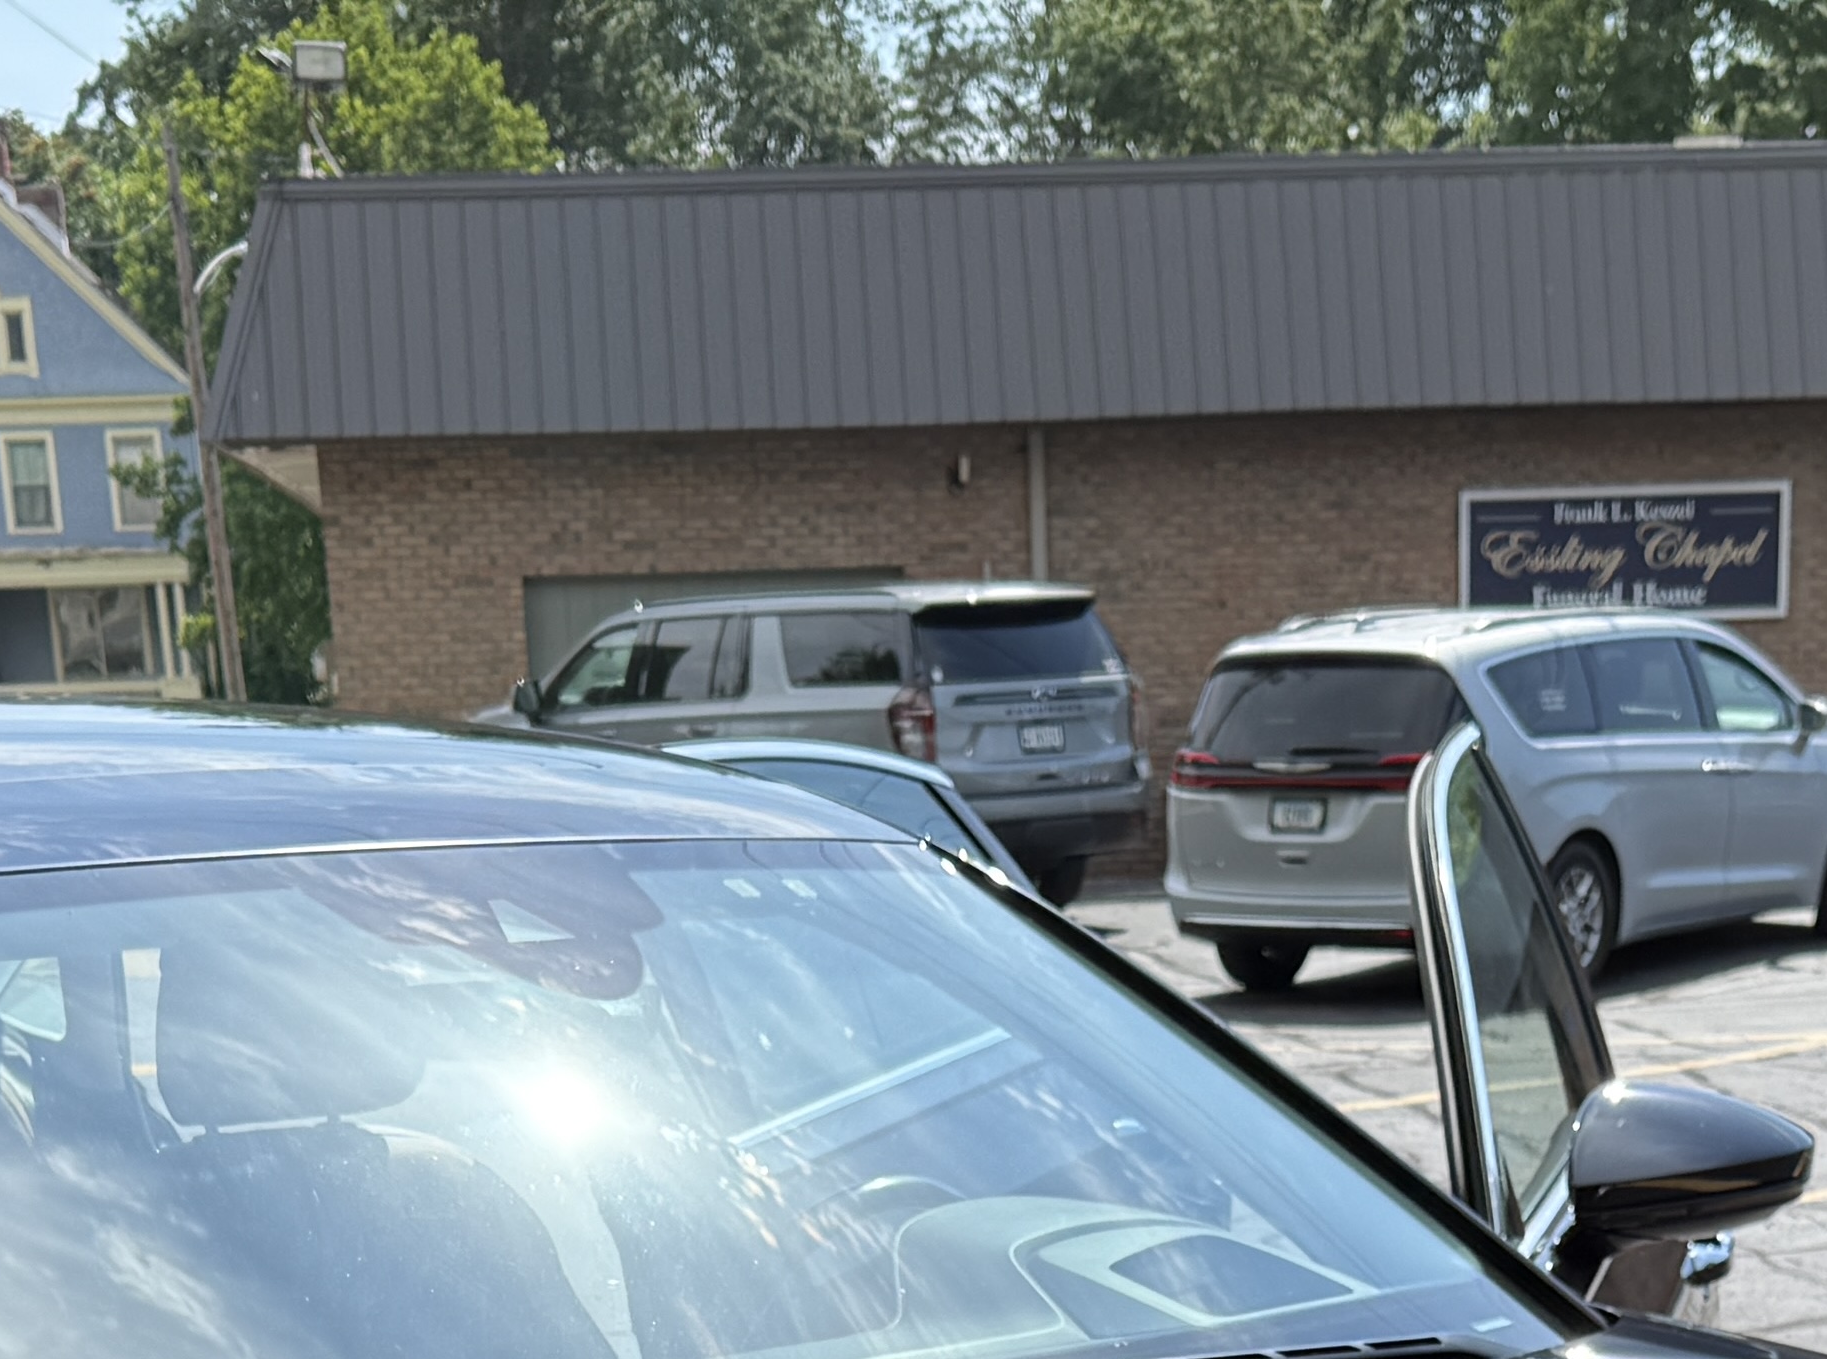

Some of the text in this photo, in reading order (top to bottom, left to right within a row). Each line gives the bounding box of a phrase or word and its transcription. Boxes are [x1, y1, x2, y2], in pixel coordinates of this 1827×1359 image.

[1635, 521, 1770, 584] Chapel
[1533, 580, 1707, 609] Funeral Home
